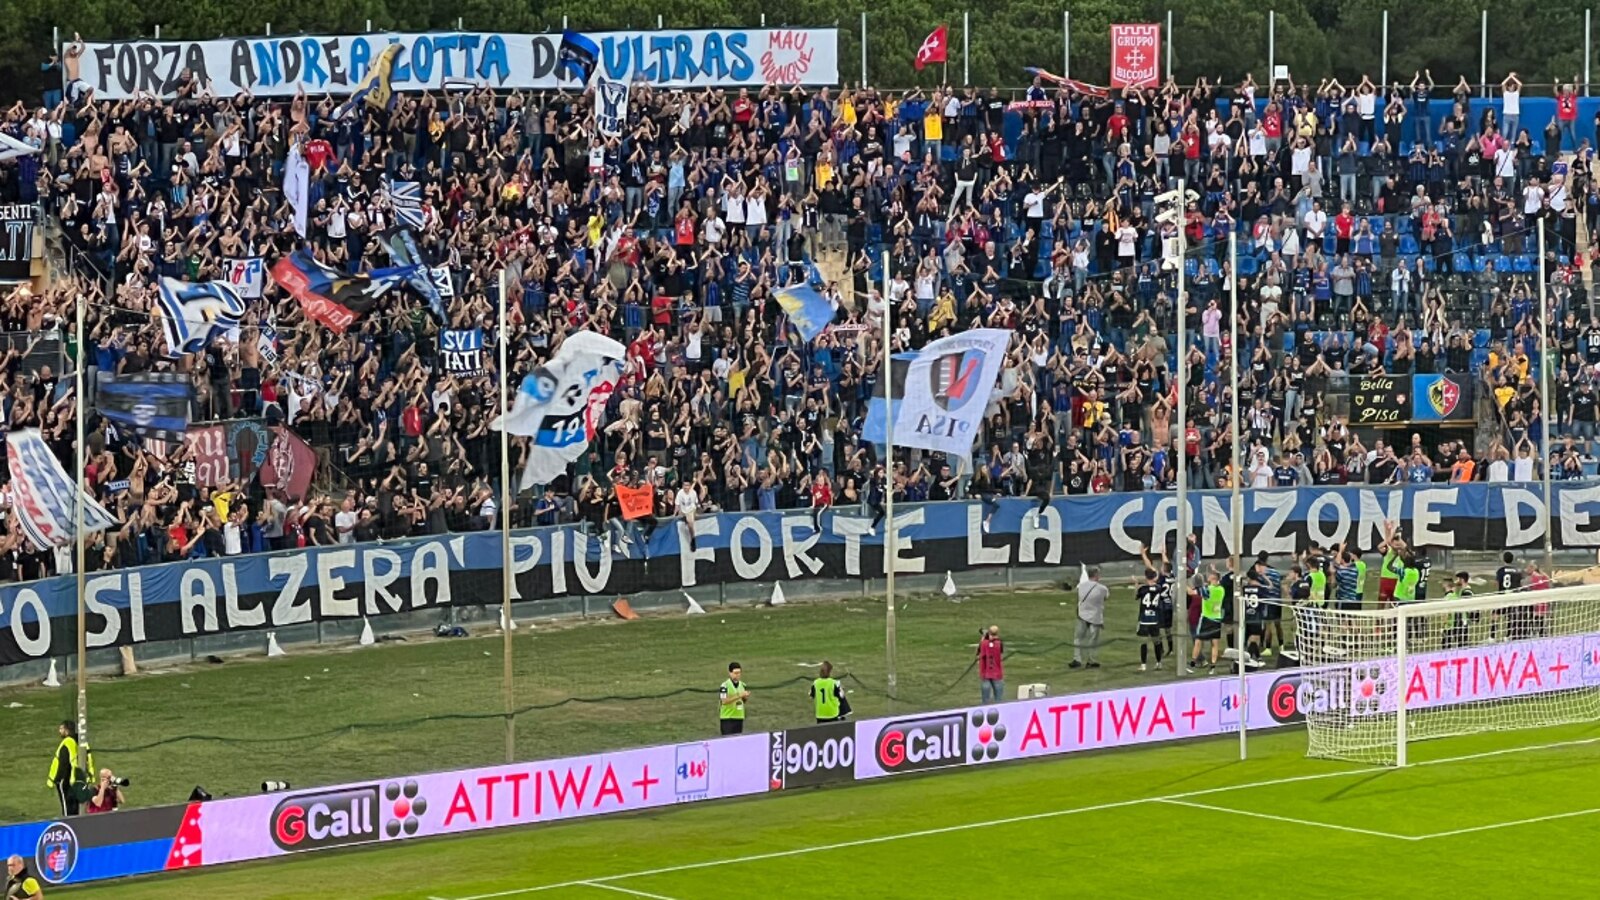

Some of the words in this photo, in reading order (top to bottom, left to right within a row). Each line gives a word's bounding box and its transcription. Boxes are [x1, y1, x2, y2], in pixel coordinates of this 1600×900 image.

[769, 30, 808, 51] MAU
[1117, 35, 1154, 46] GRUPPO
[94, 43, 211, 95] FORZA
[231, 37, 372, 88] ANDREA
[388, 35, 510, 86] LOTTA
[601, 31, 754, 83] ULTRAS
[444, 330, 476, 350] SVI
[442, 349, 482, 370] TATI
[1360, 379, 1395, 392] Bella
[84, 572, 146, 647] SI
[676, 507, 926, 586] FORTE
[967, 503, 1062, 565] LA
[1110, 487, 1459, 557] CANZONE
[1502, 574, 1512, 588] 8
[1142, 592, 1160, 608] 44
[819, 687, 826, 704] 1
[1271, 677, 1346, 718] GCall
[879, 723, 961, 767] GCall
[786, 736, 855, 776] 90:00
[276, 797, 373, 845] GCall
[42, 830, 72, 846] PISA
